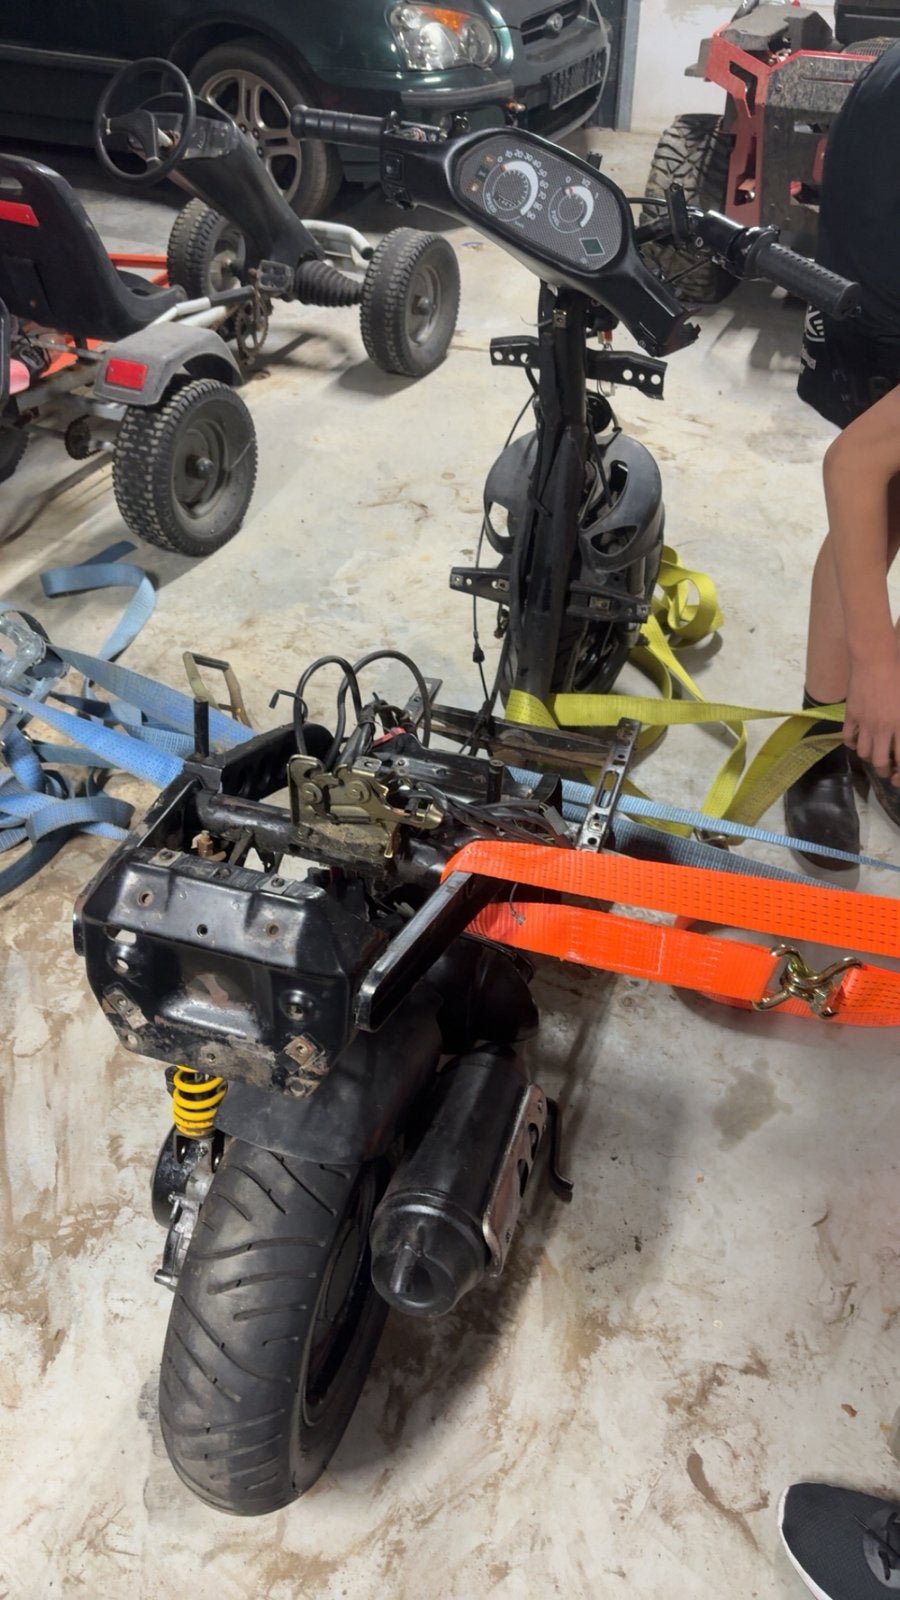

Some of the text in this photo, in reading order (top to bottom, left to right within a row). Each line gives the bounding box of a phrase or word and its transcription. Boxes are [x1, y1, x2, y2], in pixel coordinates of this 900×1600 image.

[505, 150, 513, 158] 10
[514, 149, 524, 158] 20
[524, 152, 533, 161] 30
[532, 160, 541, 168] 40
[538, 169, 548, 177] 50
[565, 175, 571, 183] 0
[540, 180, 549, 189] 60
[538, 191, 547, 200] 70
[533, 202, 543, 211] 80
[527, 211, 536, 220] 90
